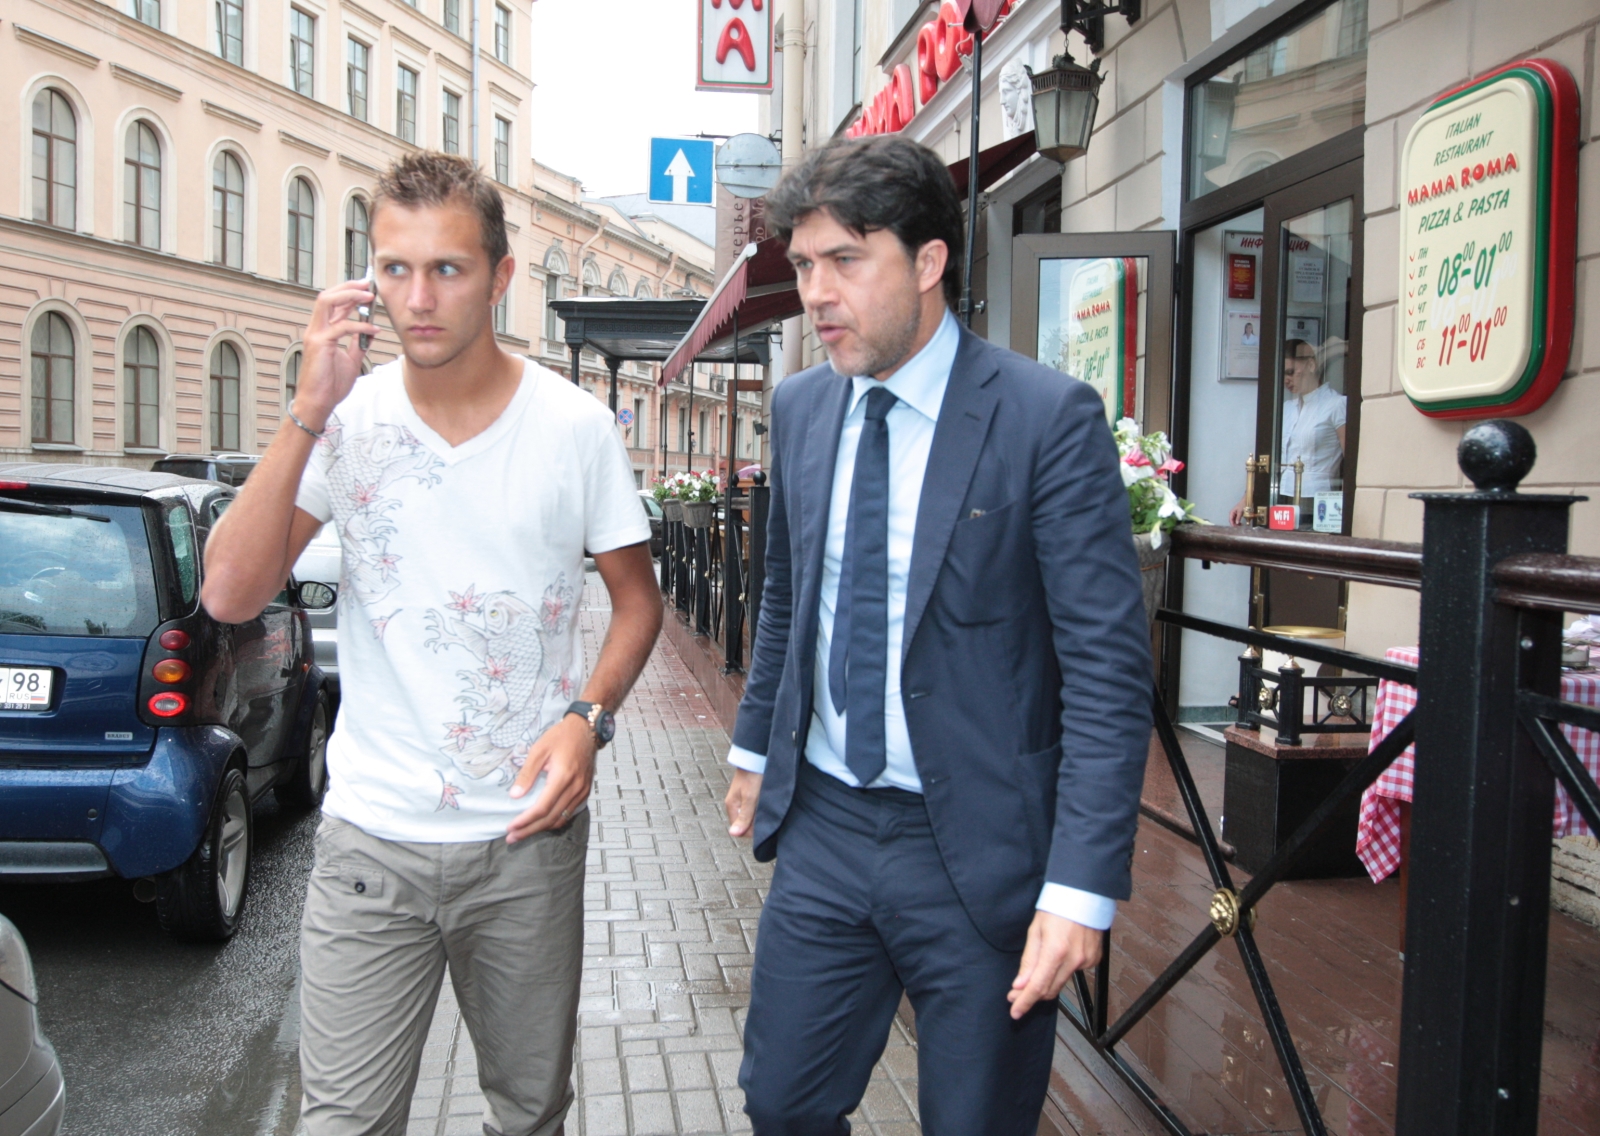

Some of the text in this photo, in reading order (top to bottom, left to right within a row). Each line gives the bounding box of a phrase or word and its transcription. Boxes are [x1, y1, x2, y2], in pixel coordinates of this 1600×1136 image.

[1445, 113, 1482, 139] ITALIAN
[1434, 130, 1494, 166] RESTAURANT
[1407, 152, 1517, 206] MAMA ROMA
[1418, 188, 1510, 234] PIZZA & PASTA
[733, 196, 748, 260] терье
[1418, 247, 1429, 260] ПН
[1418, 265, 1428, 278] ВТ
[1418, 284, 1427, 296] СР
[1092, 300, 1111, 317] ROMA
[1418, 301, 1427, 314] ЧТ
[1416, 320, 1426, 332] ПТ
[1416, 338, 1426, 351] СБ
[1416, 356, 1426, 369] ВС
[13, 672, 40, 692] 98
[9, 692, 30, 701] RUS
